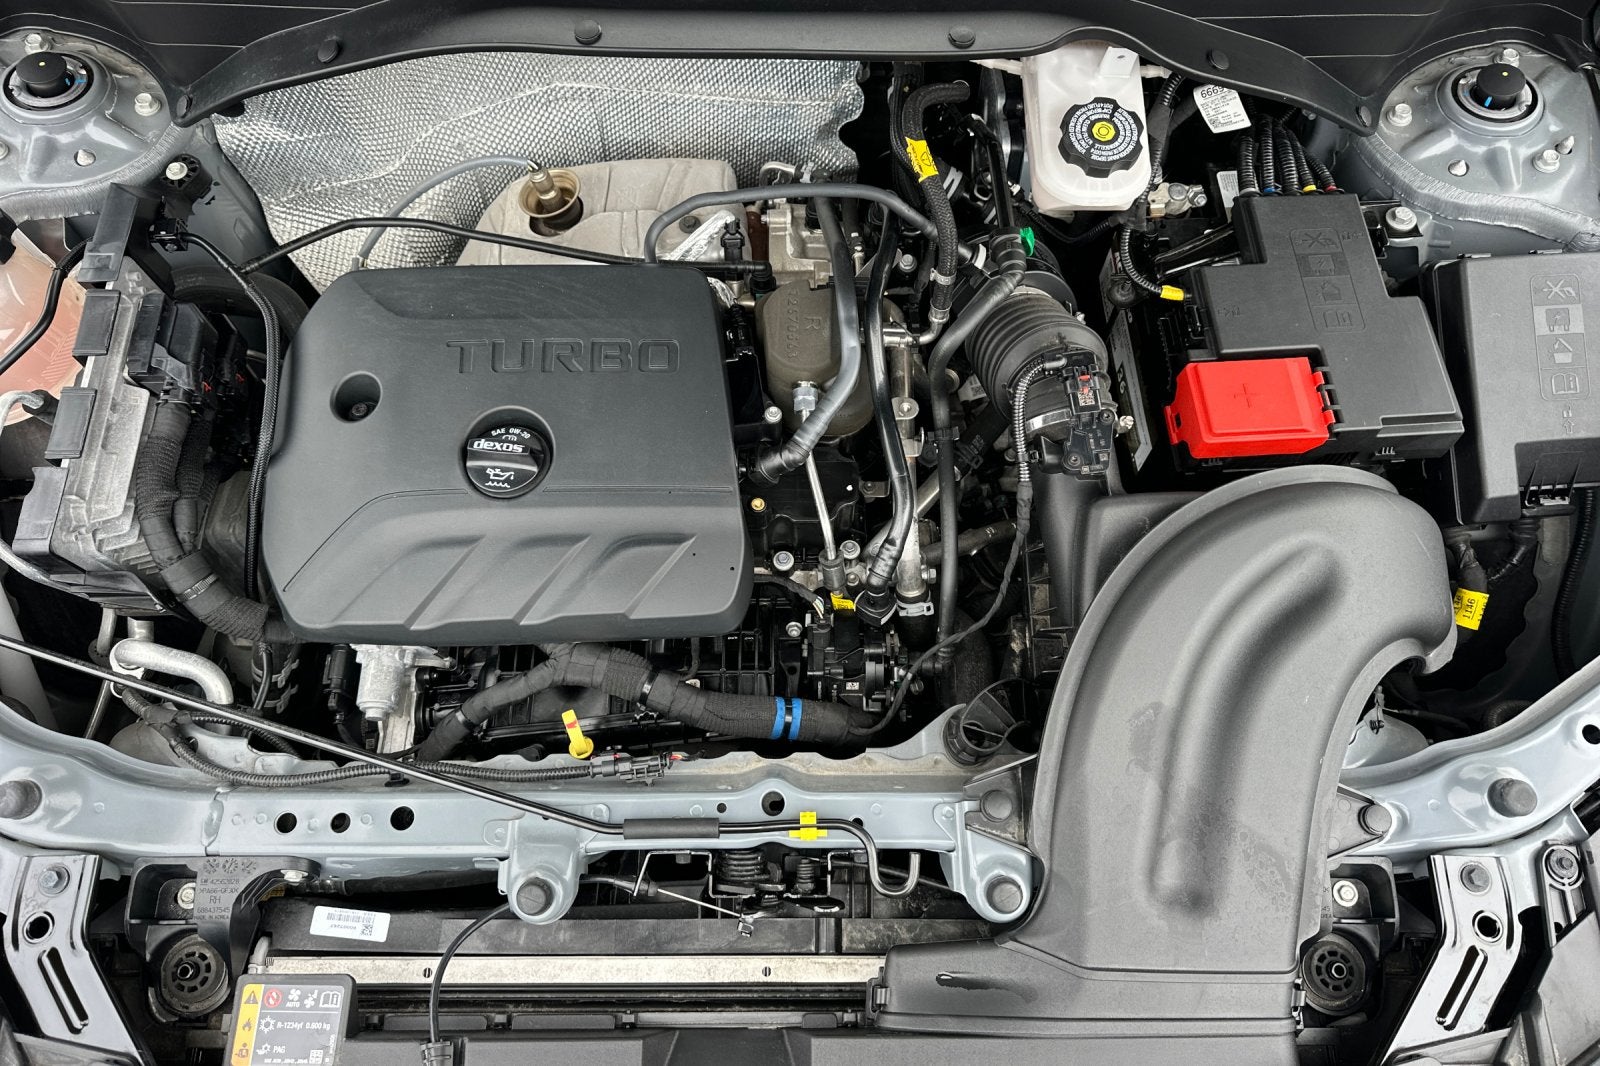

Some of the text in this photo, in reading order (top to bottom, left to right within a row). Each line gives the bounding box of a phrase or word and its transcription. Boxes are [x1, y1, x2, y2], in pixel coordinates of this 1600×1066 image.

[804, 315, 822, 330] R
[446, 338, 680, 373] TURBO
[491, 427, 531, 439] SAE 0W-20
[473, 439, 525, 453] dexos
[209, 895, 221, 904] RH
[322, 1022, 331, 1031] kg
